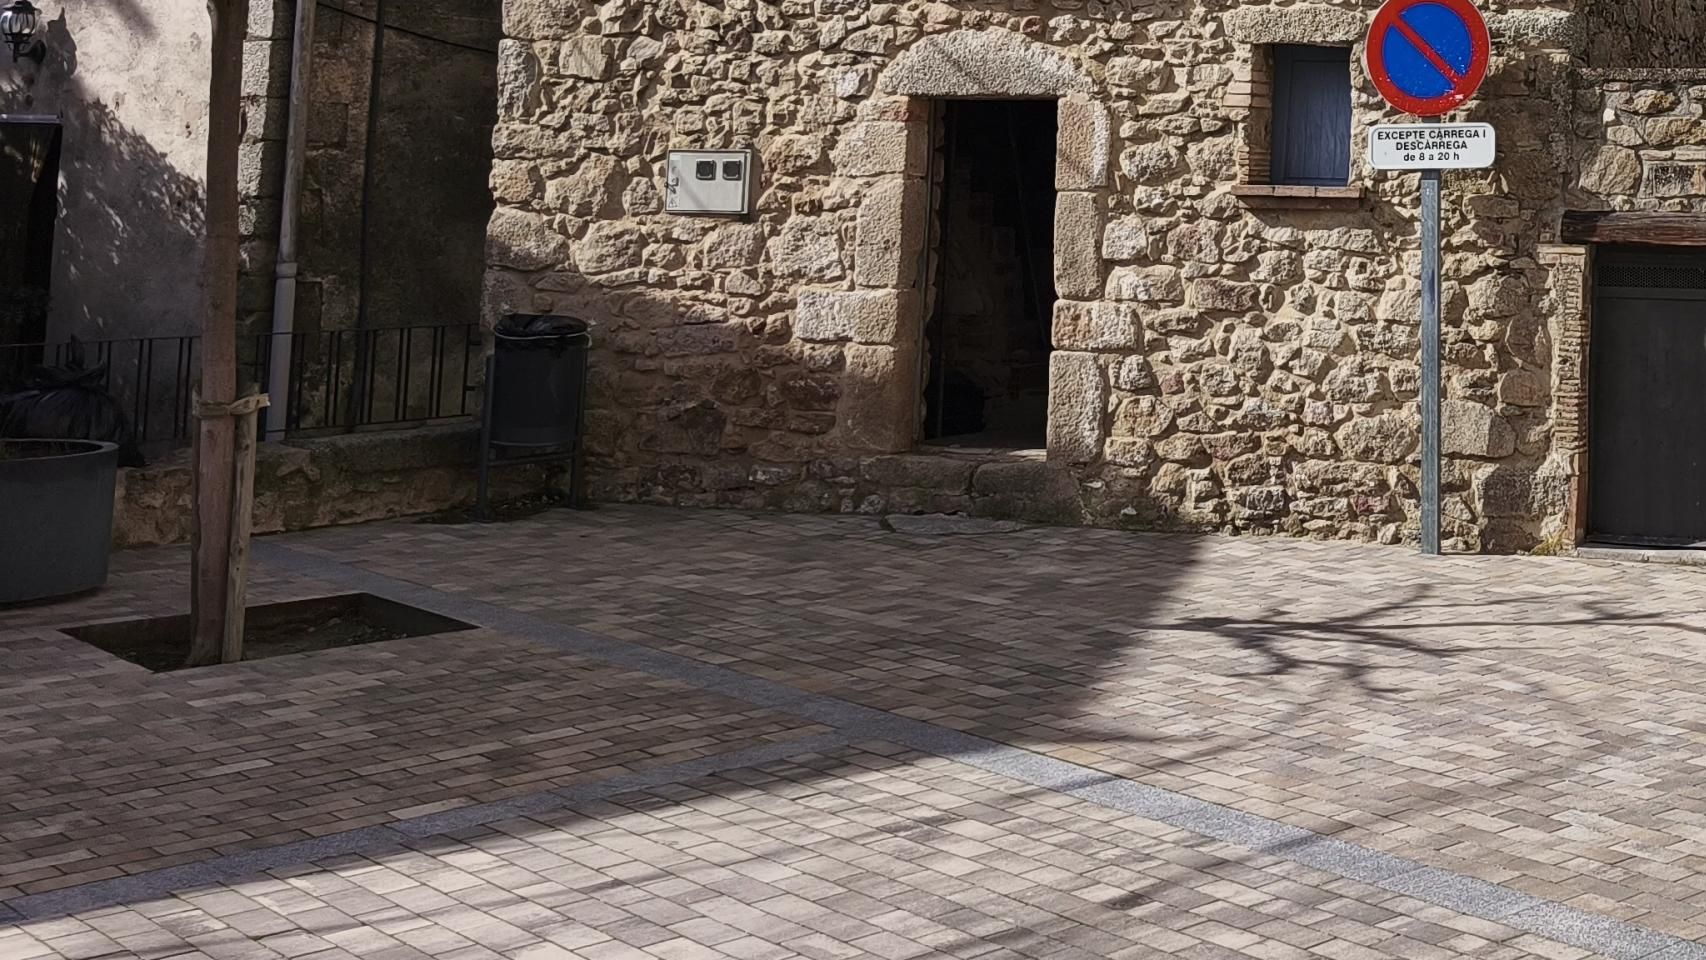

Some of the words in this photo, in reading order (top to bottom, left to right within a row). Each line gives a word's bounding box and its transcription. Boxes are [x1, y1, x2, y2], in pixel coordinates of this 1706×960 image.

[1377, 130, 1426, 140] EXCEPTE
[1403, 152, 1416, 161] de
[1418, 152, 1425, 160] 8
[1437, 151, 1450, 160] 20
[1453, 151, 1460, 160] h
